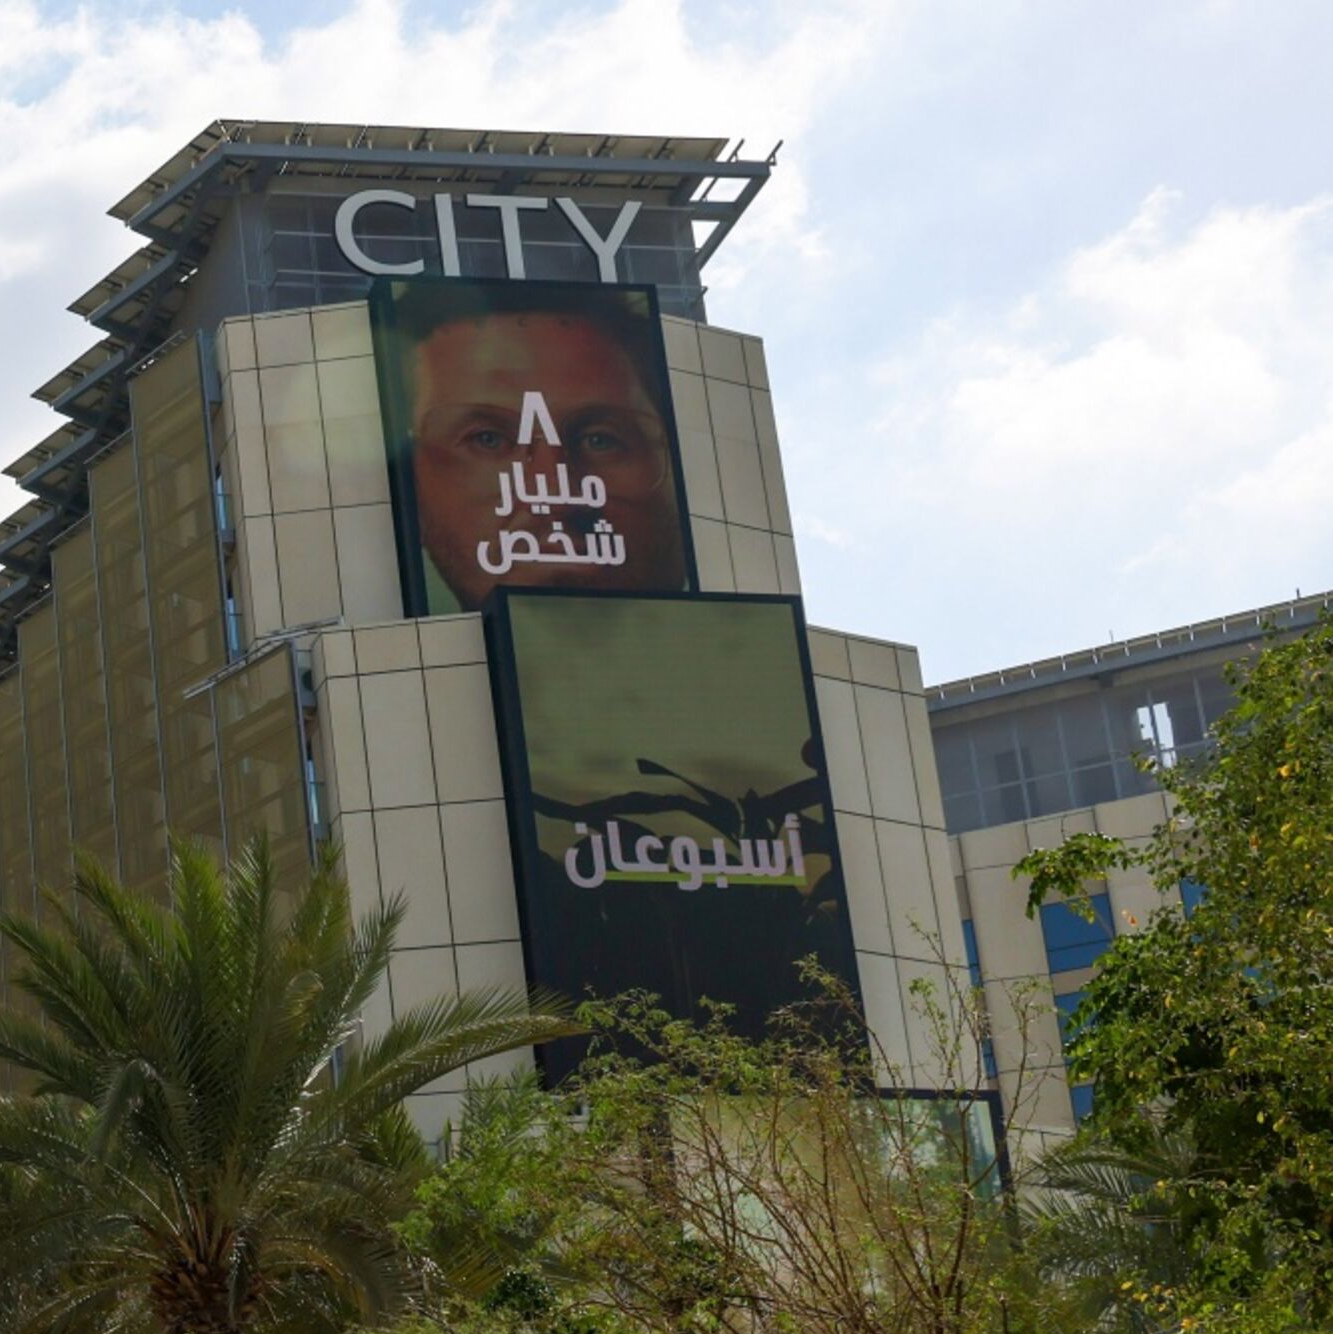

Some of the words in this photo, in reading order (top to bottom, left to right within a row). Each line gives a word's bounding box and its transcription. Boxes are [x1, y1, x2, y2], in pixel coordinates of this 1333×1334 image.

[335, 189, 642, 283] CITY
[495, 461, 607, 516] مليار
[477, 519, 626, 575] شخص
[565, 812, 805, 890] أسبوعان
